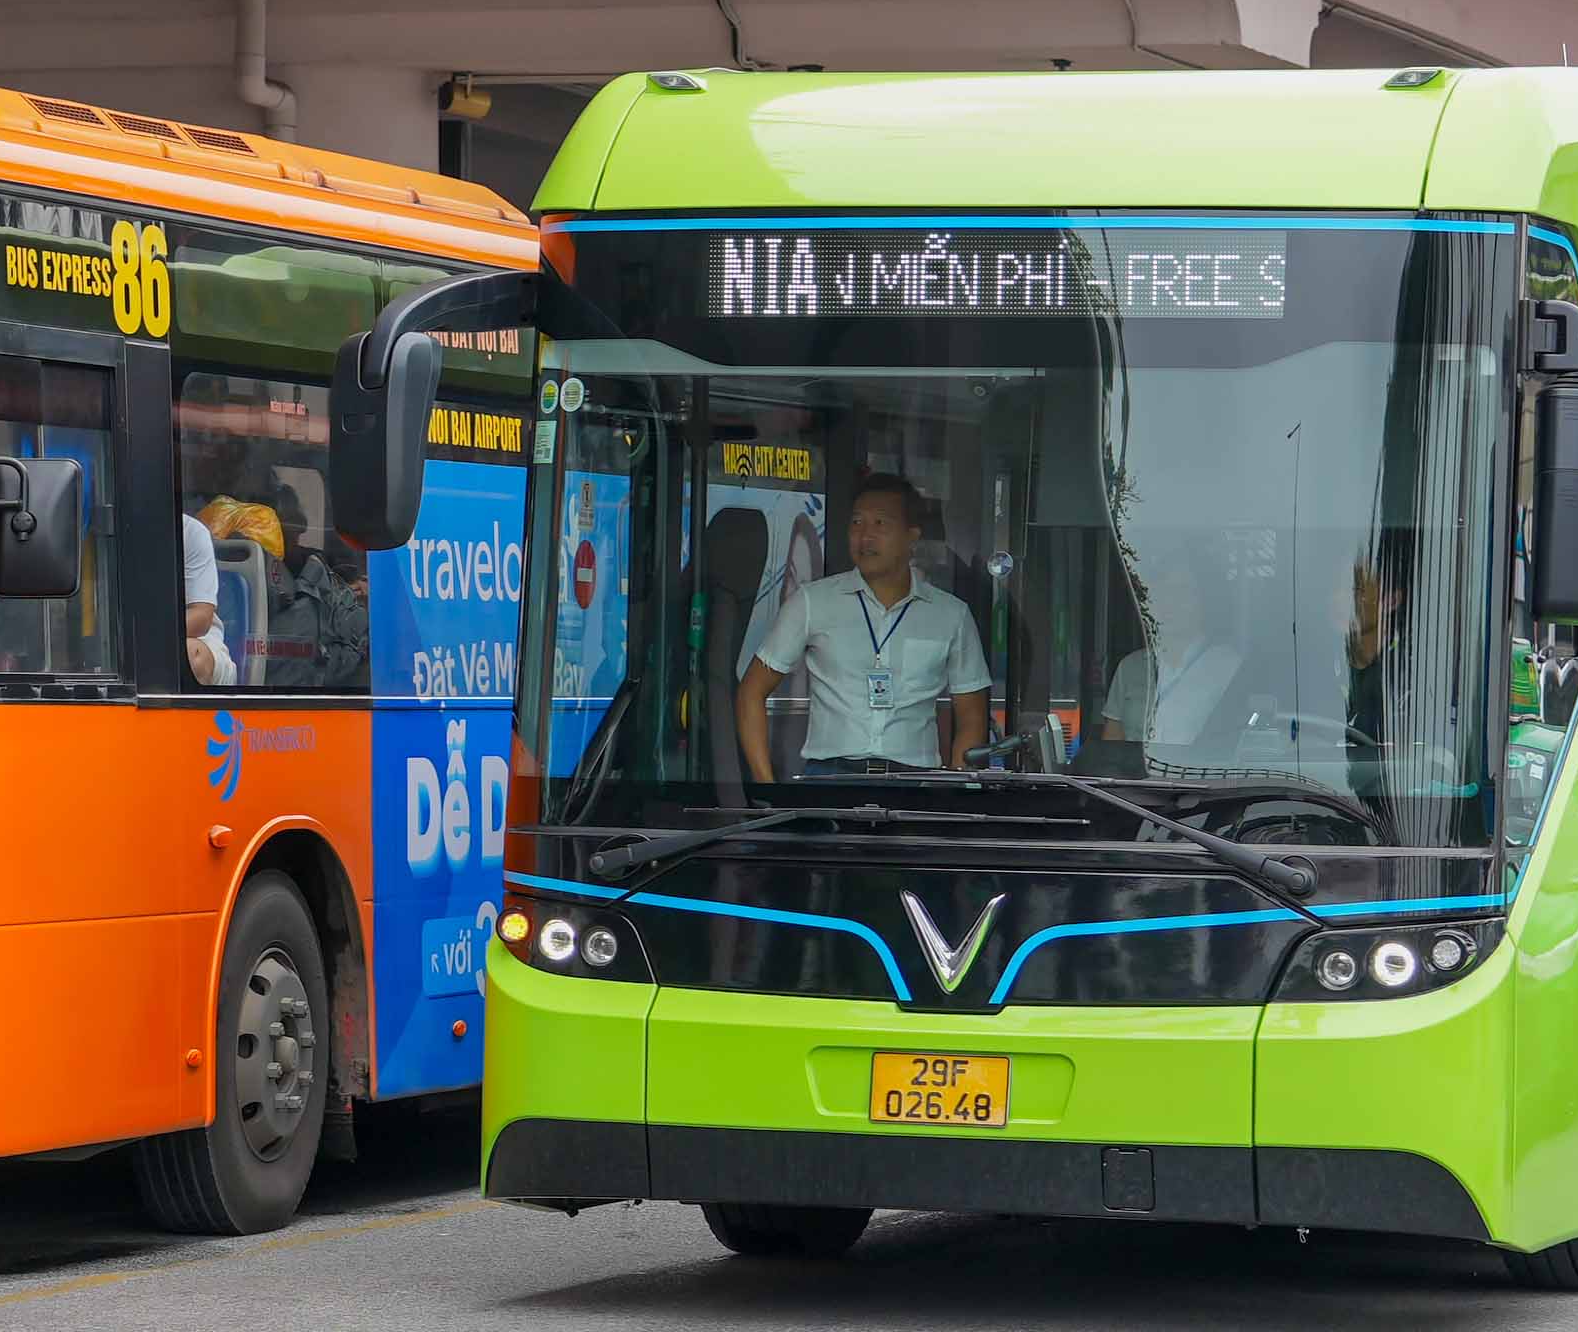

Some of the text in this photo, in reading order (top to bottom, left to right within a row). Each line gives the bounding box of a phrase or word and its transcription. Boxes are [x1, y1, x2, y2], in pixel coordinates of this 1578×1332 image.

[5, 219, 171, 338] BUS EXPRESS 86
[722, 237, 819, 317] NIA
[870, 233, 980, 307] MIỄN
[996, 238, 1069, 307] PHÍ
[1126, 254, 1240, 308] FREE
[450, 409, 472, 447] BAI
[474, 412, 522, 453] AIRPORT
[754, 445, 774, 477] CITY
[775, 447, 811, 481] CENTER
[459, 640, 490, 695] Vé
[406, 718, 472, 868] Dễ
[442, 928, 472, 977] với
[910, 1058, 970, 1088] 29F
[885, 1089, 992, 1122] 026.48
